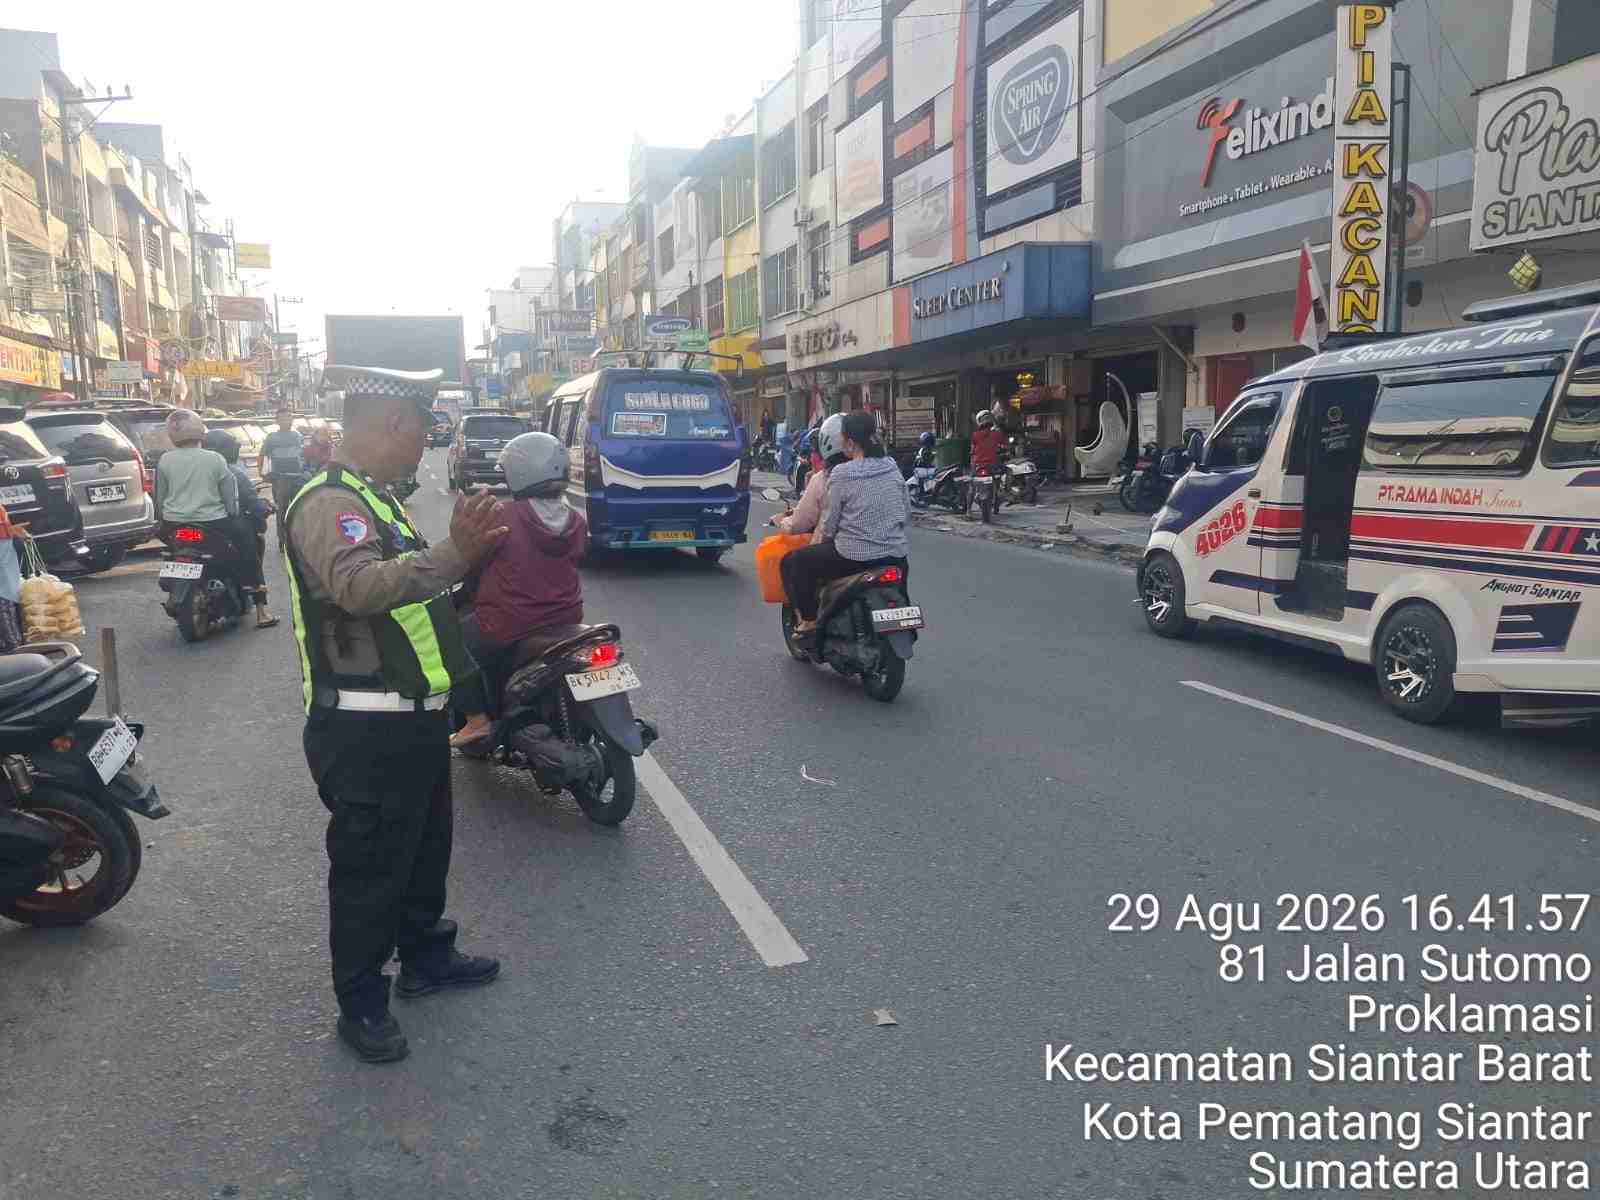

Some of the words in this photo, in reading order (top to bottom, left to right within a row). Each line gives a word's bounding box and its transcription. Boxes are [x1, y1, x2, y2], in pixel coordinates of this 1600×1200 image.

[1344, 5, 1387, 125] PIA
[1007, 72, 1054, 113] SPRING
[1018, 111, 1041, 136] AIR
[1484, 86, 1600, 195] Pia
[1179, 193, 1228, 216] Smartphone
[1234, 181, 1263, 201] Tablet
[1270, 164, 1316, 190] Wearable
[1337, 143, 1388, 333] KACAN
[912, 297, 945, 320] SLEEP
[949, 277, 1000, 310] CENTER
[1440, 487, 1483, 506] INDAH
[1194, 499, 1248, 557] 4026
[1530, 583, 1582, 602] SIANTAR
